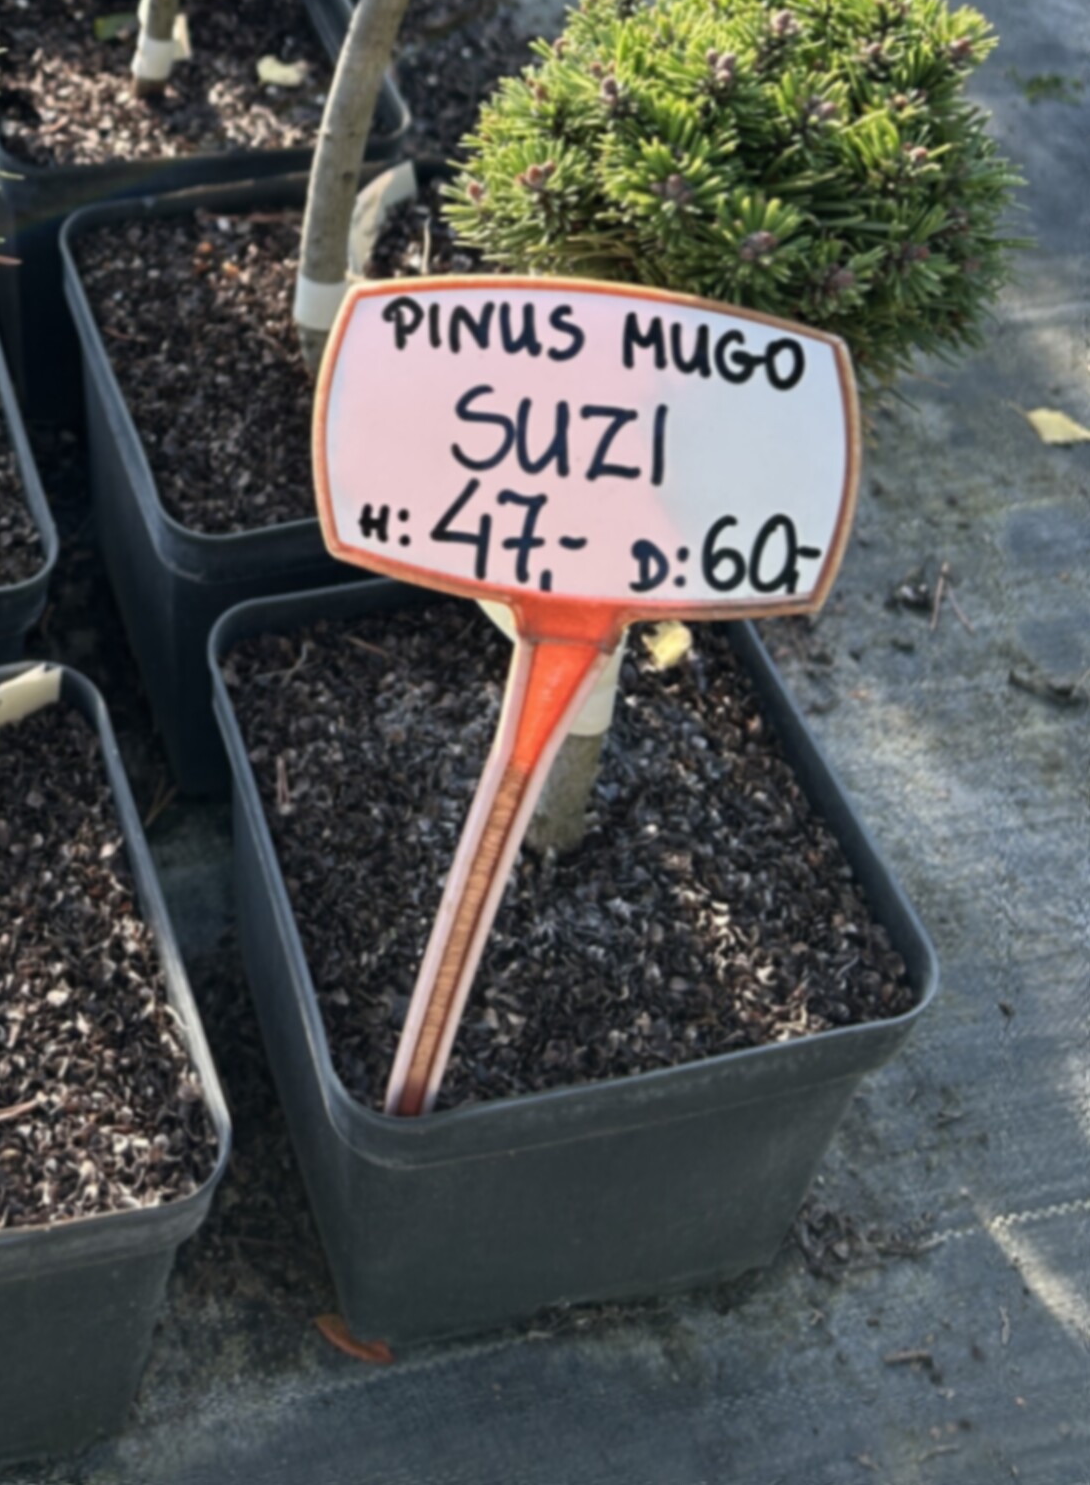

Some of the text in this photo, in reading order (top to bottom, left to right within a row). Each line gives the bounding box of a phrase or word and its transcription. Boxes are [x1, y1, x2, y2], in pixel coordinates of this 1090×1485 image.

[381, 297, 806, 391] PINUS MUGO
[451, 385, 668, 486] SUZI
